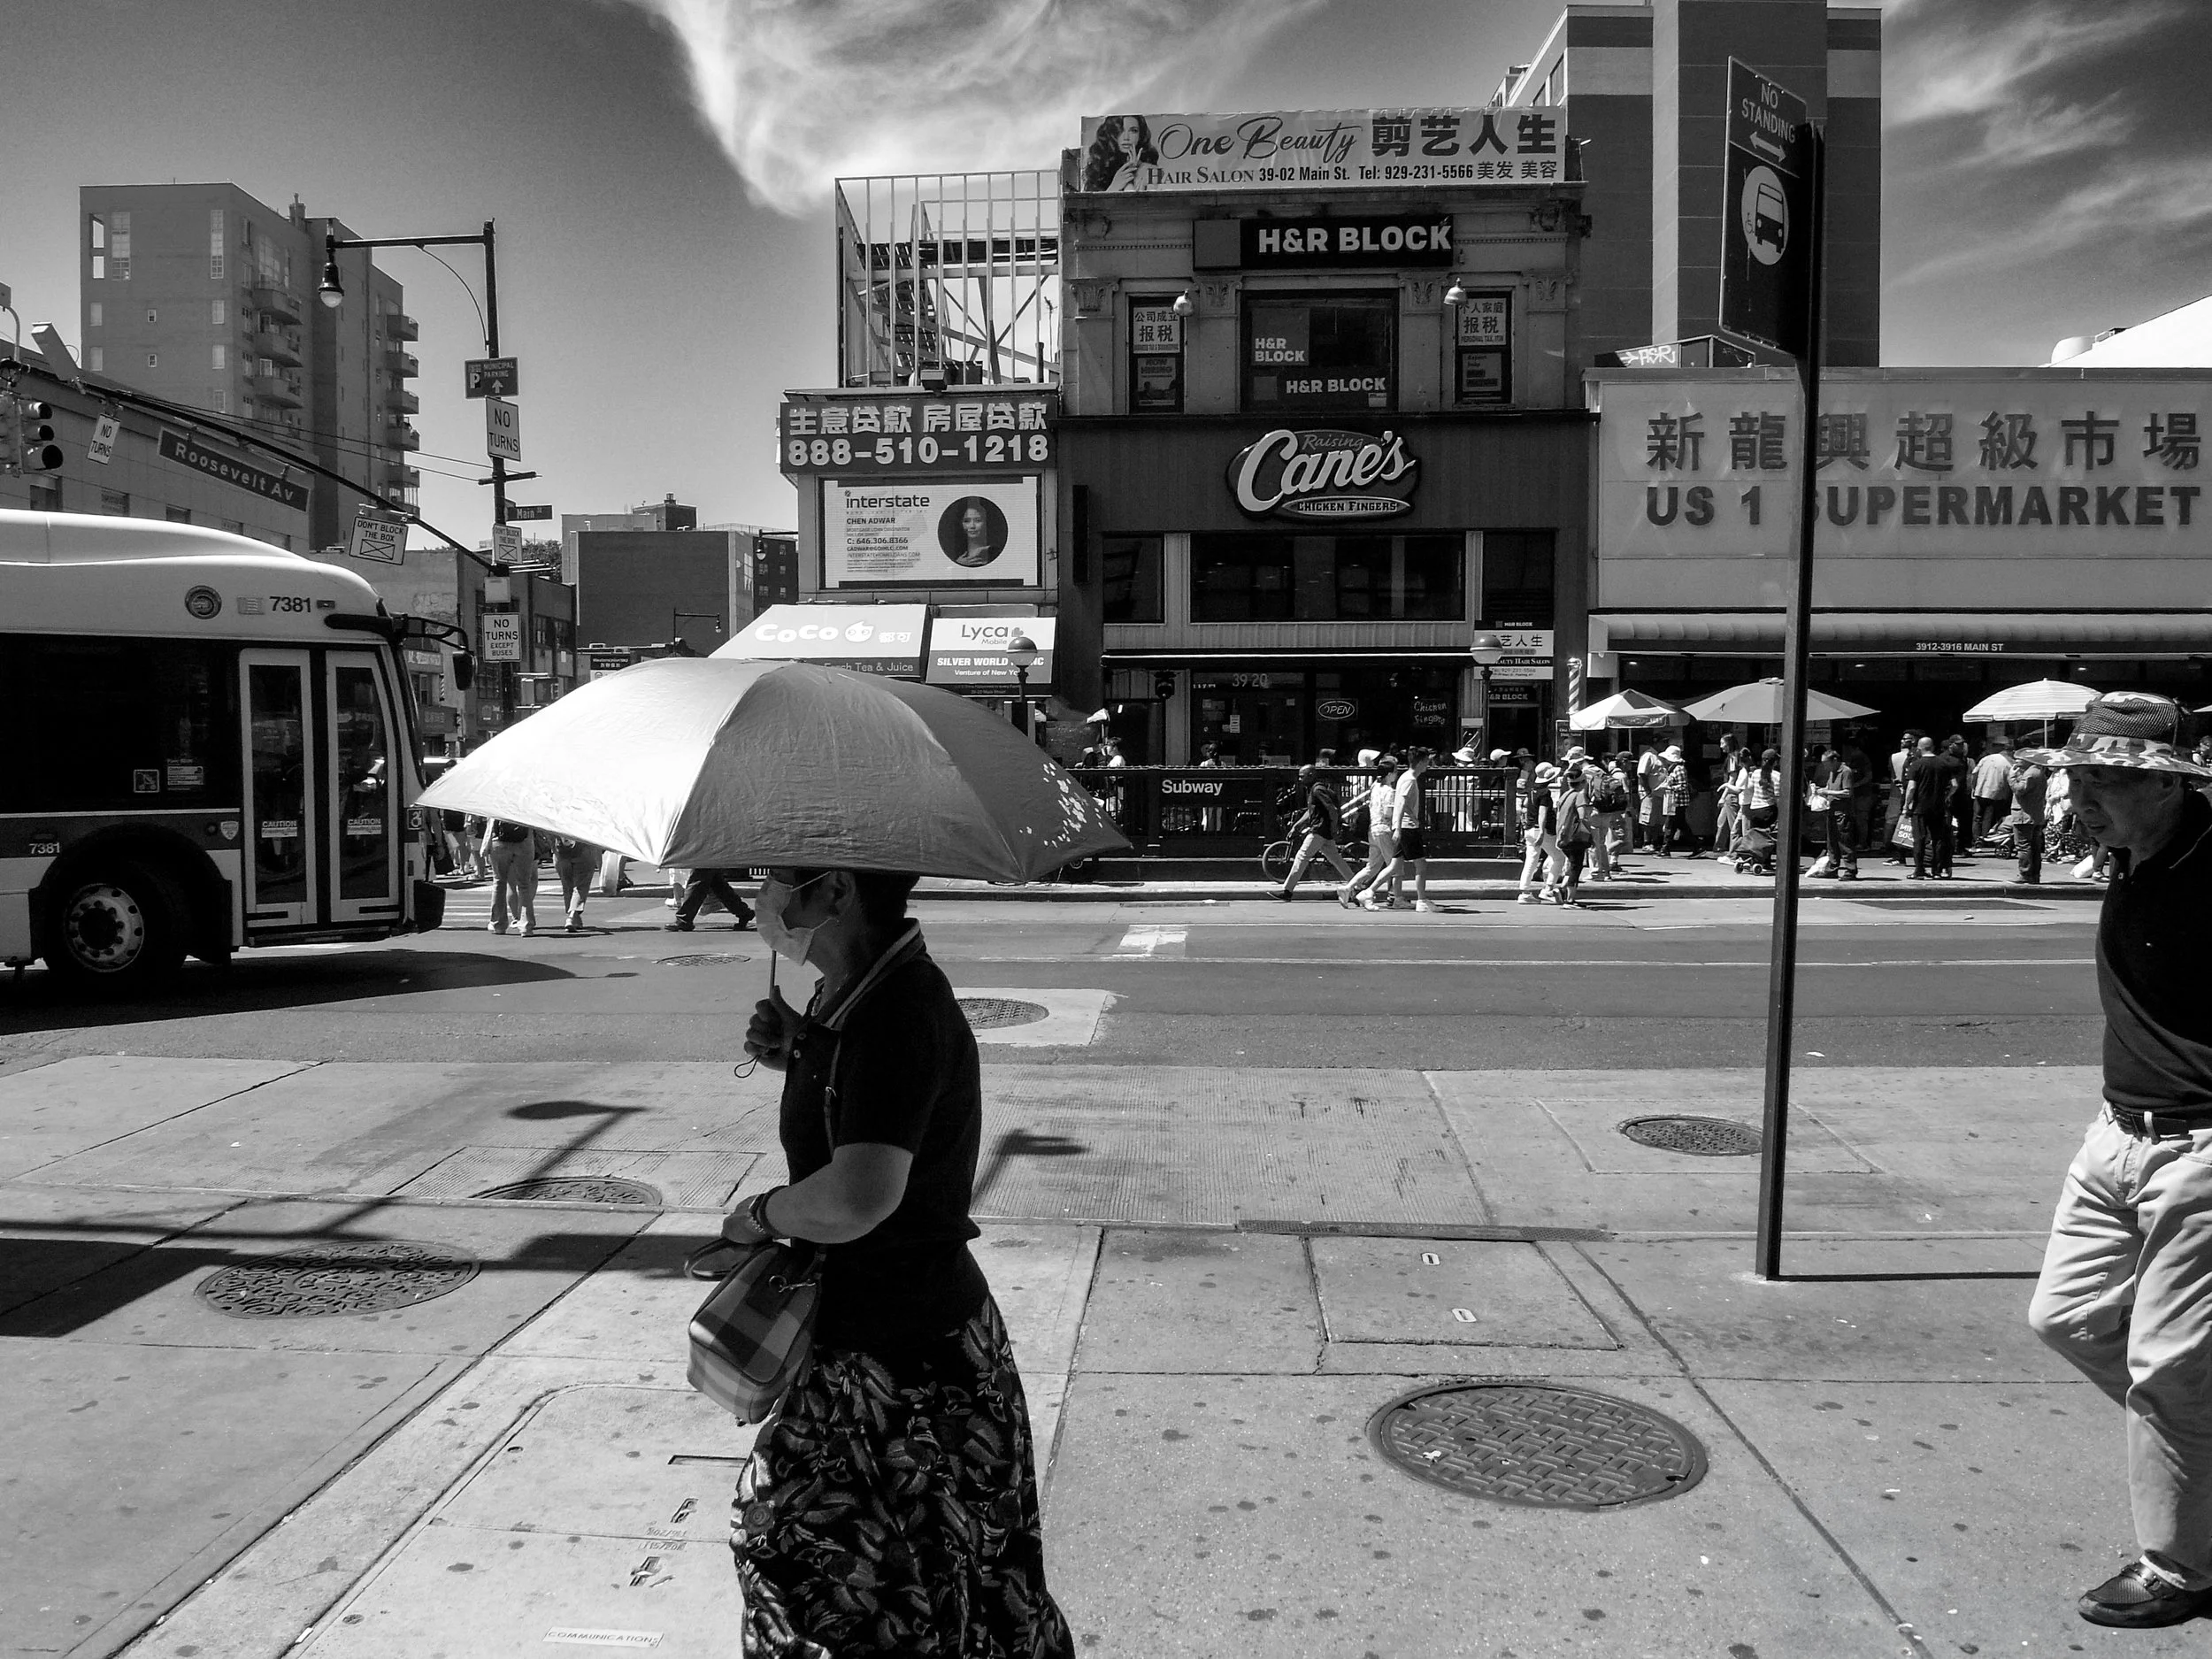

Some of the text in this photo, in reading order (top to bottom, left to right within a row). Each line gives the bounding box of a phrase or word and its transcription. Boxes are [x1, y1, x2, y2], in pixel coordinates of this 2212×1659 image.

[1761, 83, 1778, 109] NO
[1741, 98, 1795, 143] STANDING
[1157, 116, 1363, 164] One Beauty
[1372, 113, 1556, 157] 剪艺人生
[1259, 166, 1295, 181] 39-02
[1299, 166, 1329, 180] Main
[1334, 166, 1350, 180] St.
[1359, 165, 1380, 180] Tel:
[1385, 165, 1473, 180] 929-231-5566
[1258, 226, 1452, 253] H&R BLOCK
[1139, 325, 1173, 342] 报税
[1463, 316, 1499, 334] 报税
[1255, 338, 1286, 349] H&R
[1255, 350, 1305, 362] BLOCK
[1286, 377, 1386, 394] H&R BLOCK
[494, 408, 511, 428] NO
[100, 424, 112, 439] NO
[91, 441, 112, 458] TURNS
[488, 432, 518, 452] TURNS
[788, 434, 1048, 465] 888-510-1218
[1302, 434, 1364, 451] Raising
[1646, 411, 2200, 472] 新龍興超級市場
[175, 442, 294, 502] Roosevelt Av
[1237, 429, 1416, 511] Cane's
[846, 492, 930, 509] interstate
[1647, 486, 2200, 526] US 1 UPERMARKET
[517, 508, 535, 519] Main
[357, 520, 404, 535] DON'T BLOCK
[365, 530, 395, 542] THE BOX
[270, 595, 311, 613] 7381
[494, 619, 510, 628] NO
[485, 631, 518, 641] TURNS
[755, 623, 839, 643] CoCo
[961, 624, 1009, 641] Lyca
[1916, 642, 1962, 651] 3912-3916
[1964, 642, 1989, 651] MAIN
[855, 662, 873, 672] Tea
[876, 663, 884, 672] &
[887, 662, 914, 672] Juice
[937, 657, 972, 666] SILVER
[973, 657, 1009, 666] WORLD
[1414, 701, 1448, 712] Chicken
[1162, 780, 1223, 796] Subway
[28, 842, 60, 855] 7381
